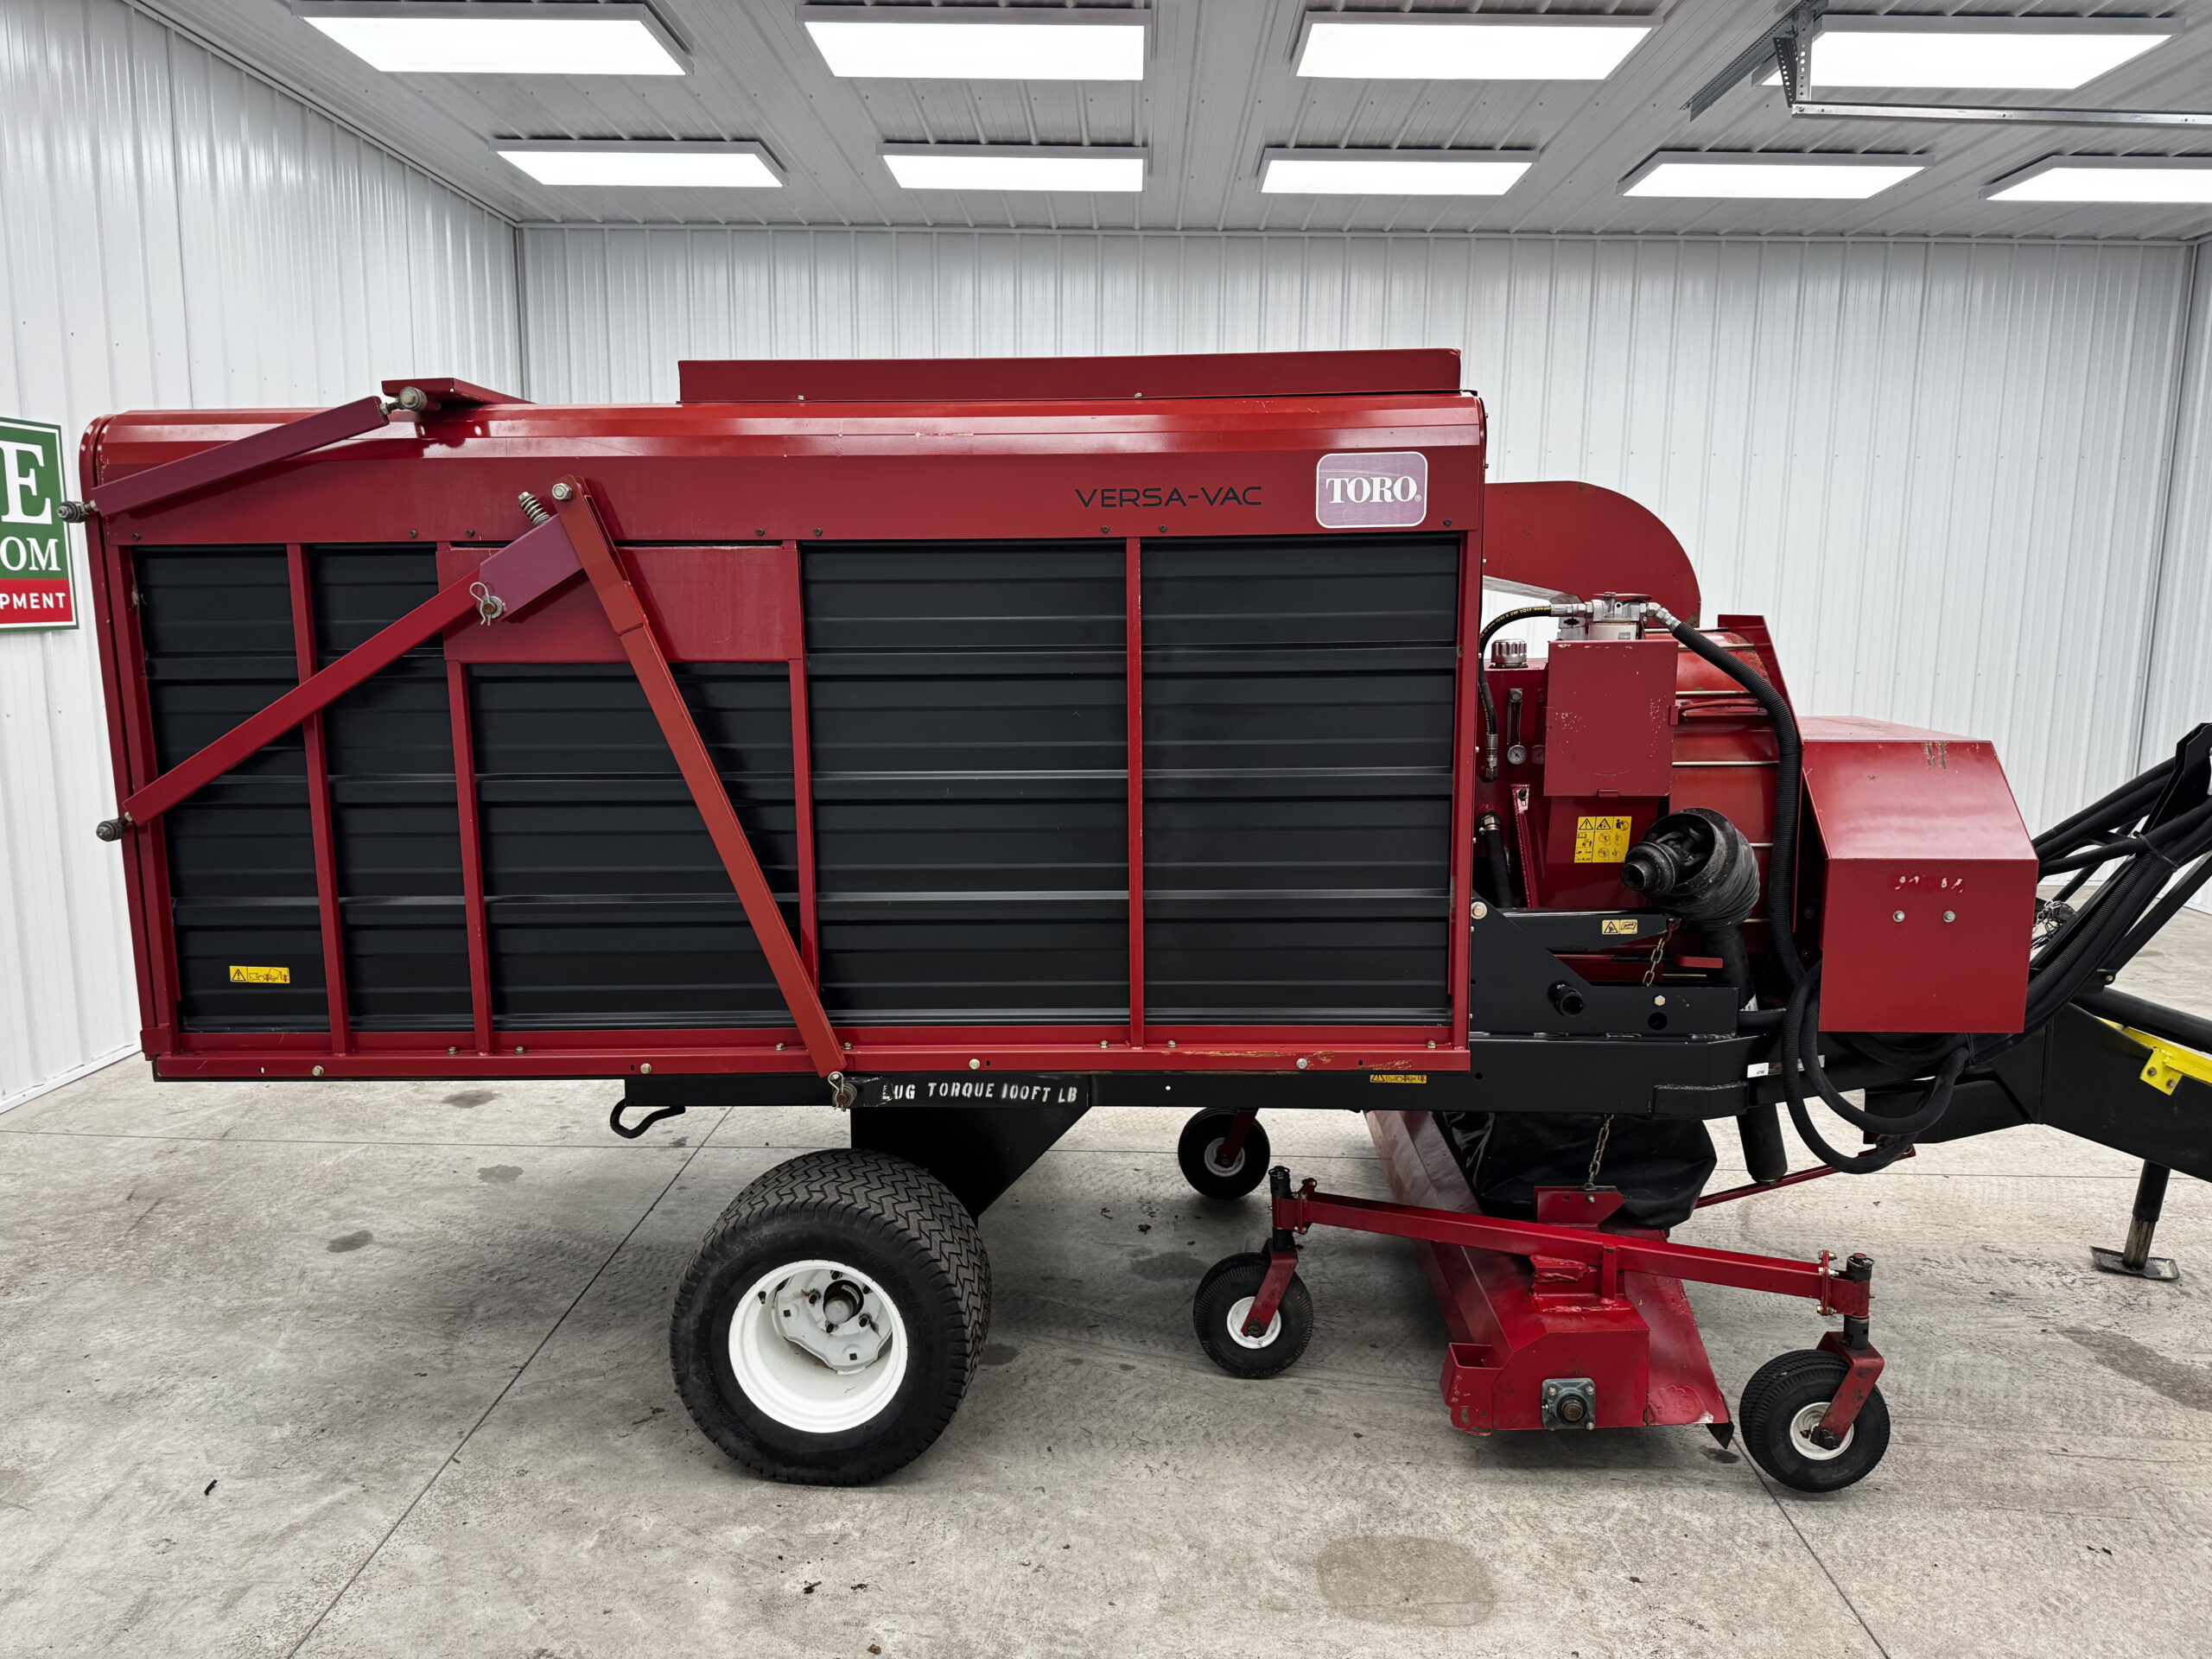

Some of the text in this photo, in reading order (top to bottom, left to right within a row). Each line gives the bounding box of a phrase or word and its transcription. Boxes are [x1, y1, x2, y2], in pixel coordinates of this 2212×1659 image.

[1075, 486, 1262, 508] VERSA-VAC
[1325, 475, 1418, 504] TORO
[928, 1082, 995, 1099] TORQUE
[1058, 1086, 1077, 1103] LB
